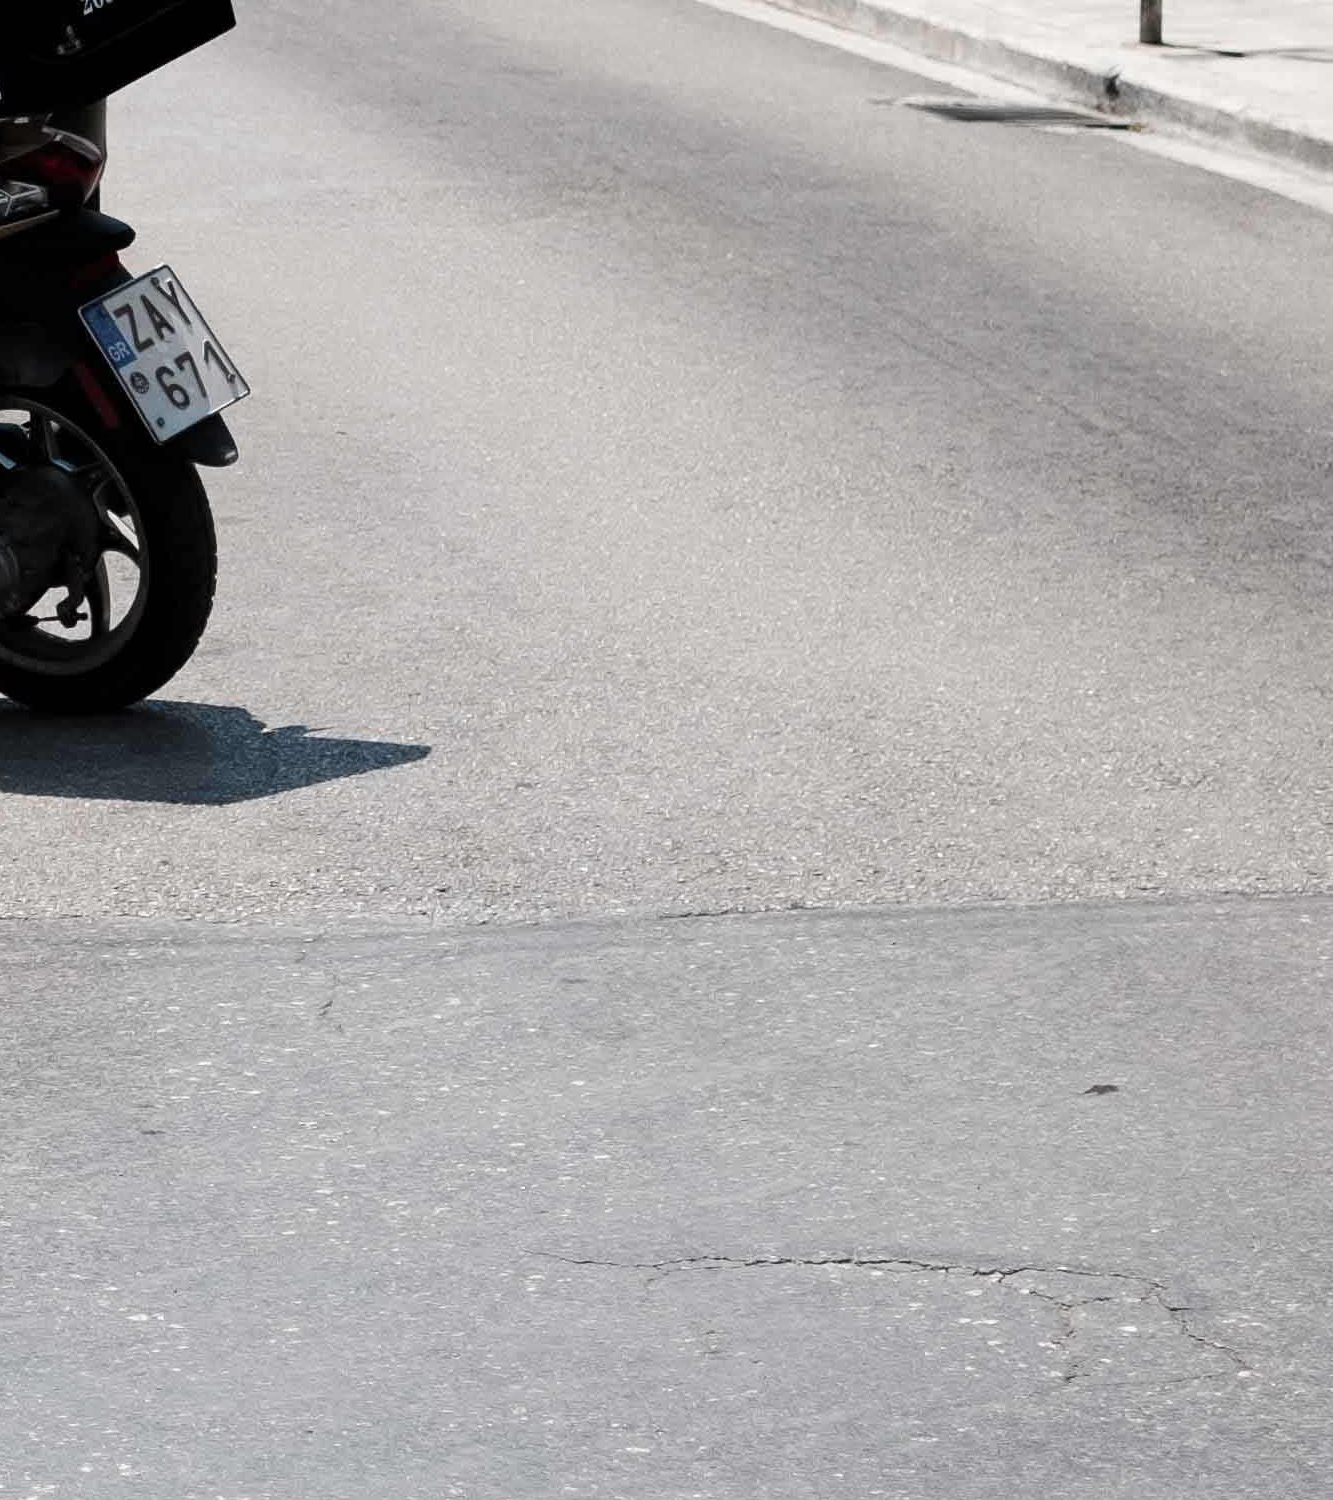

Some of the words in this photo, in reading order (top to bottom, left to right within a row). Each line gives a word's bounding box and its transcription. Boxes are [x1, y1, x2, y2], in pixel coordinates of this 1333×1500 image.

[108, 341, 131, 362] GR
[113, 279, 192, 353] ZAY
[155, 339, 236, 411] 671
